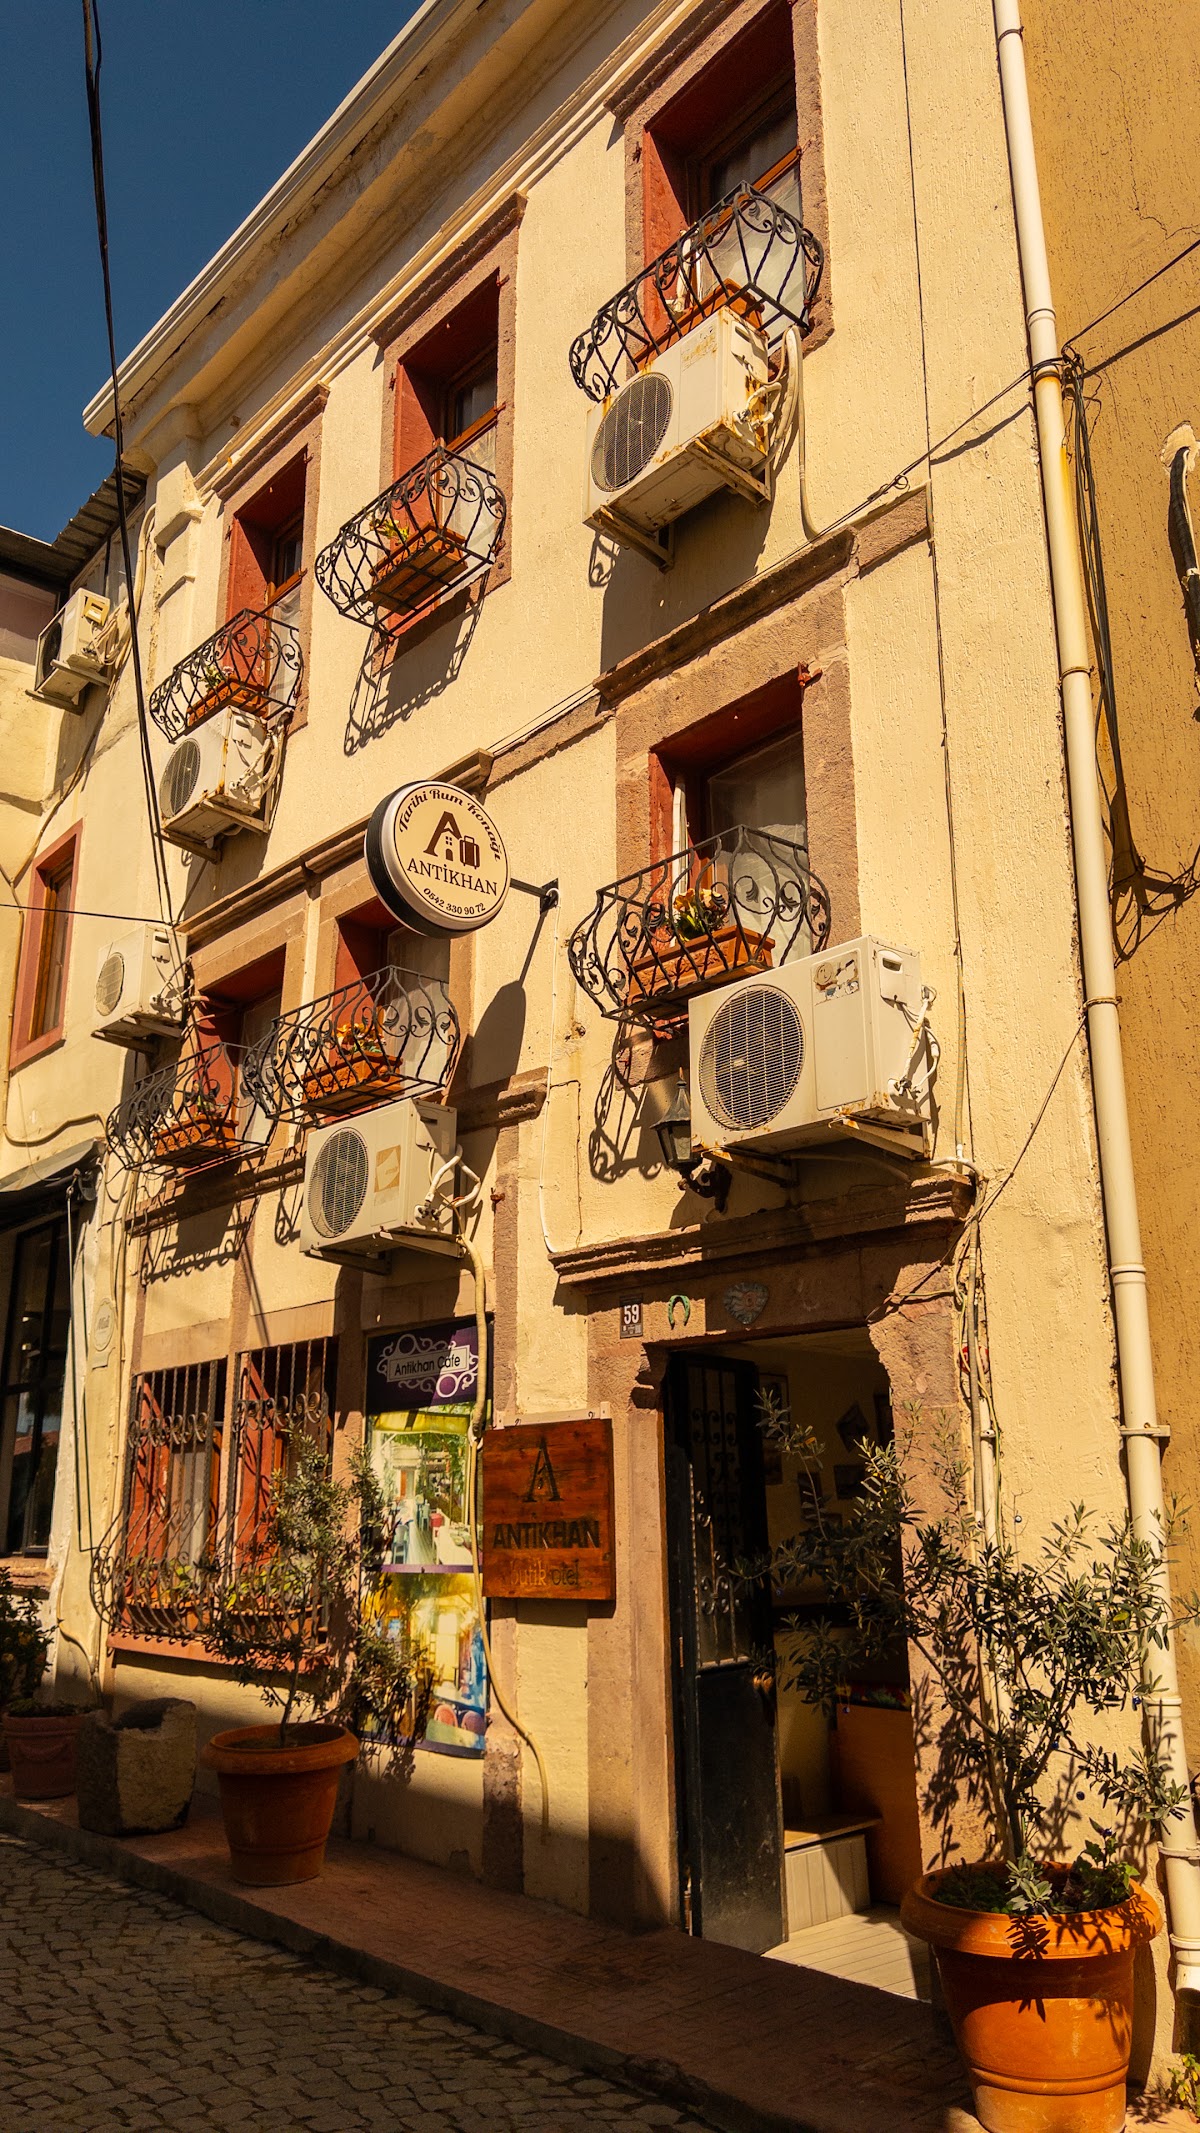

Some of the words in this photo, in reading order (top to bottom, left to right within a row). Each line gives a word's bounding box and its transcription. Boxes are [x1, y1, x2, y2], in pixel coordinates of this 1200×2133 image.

[399, 790, 428, 833] Tarihi
[429, 788, 463, 806] Rum
[407, 857, 498, 897] ANTİKHAN
[423, 887, 445, 908] 0542
[445, 902, 463, 915] 330
[464, 906, 475, 916] 90
[475, 902, 486, 913] 72
[623, 1303, 640, 1325] 59
[394, 1360, 435, 1377] Antikhan
[437, 1354, 461, 1370] Cafe
[549, 1558, 580, 1586] otel
